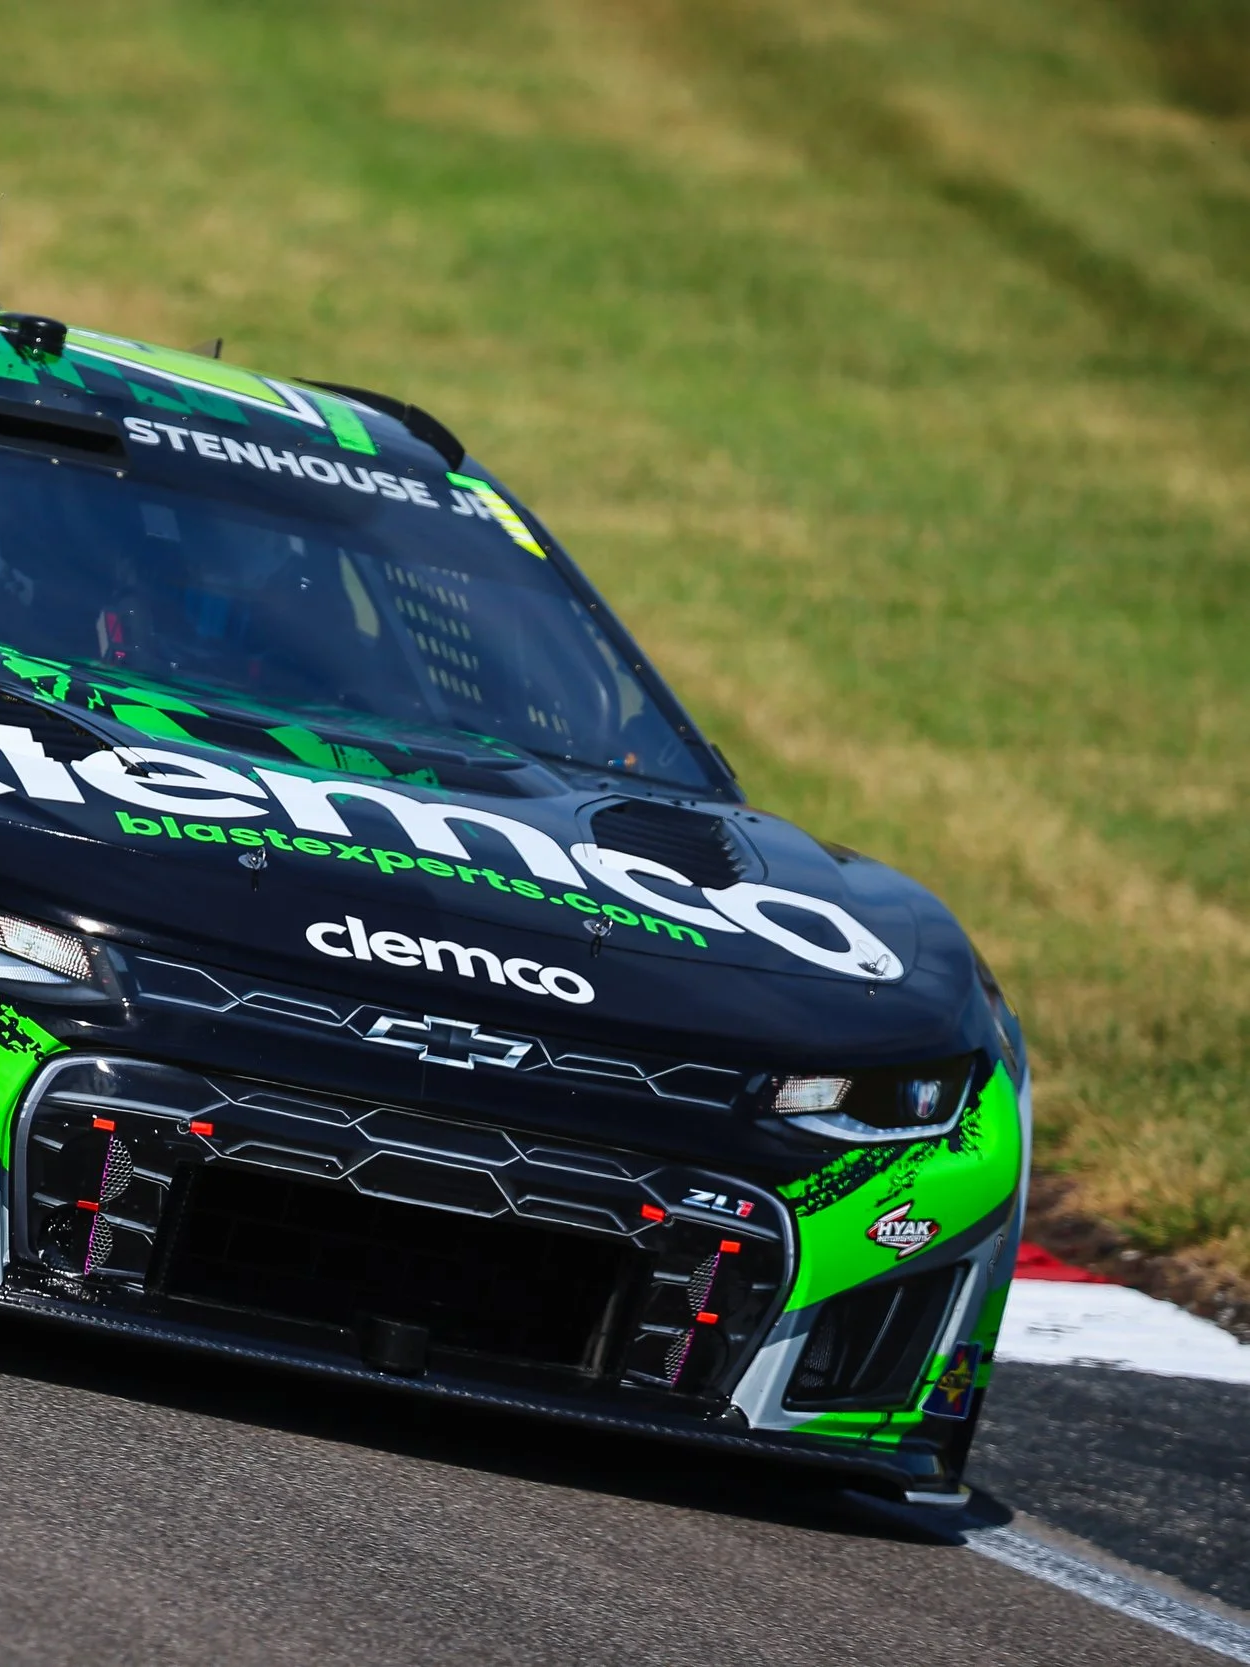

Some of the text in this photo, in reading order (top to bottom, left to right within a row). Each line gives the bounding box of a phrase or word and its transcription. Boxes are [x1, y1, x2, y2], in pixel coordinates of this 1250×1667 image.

[121, 415, 441, 510] STENHOUSE
[114, 810, 708, 949] blastexperts.com
[305, 915, 596, 1004] clemco
[682, 1188, 755, 1218] ZL1
[876, 1220, 933, 1236] HYAK
